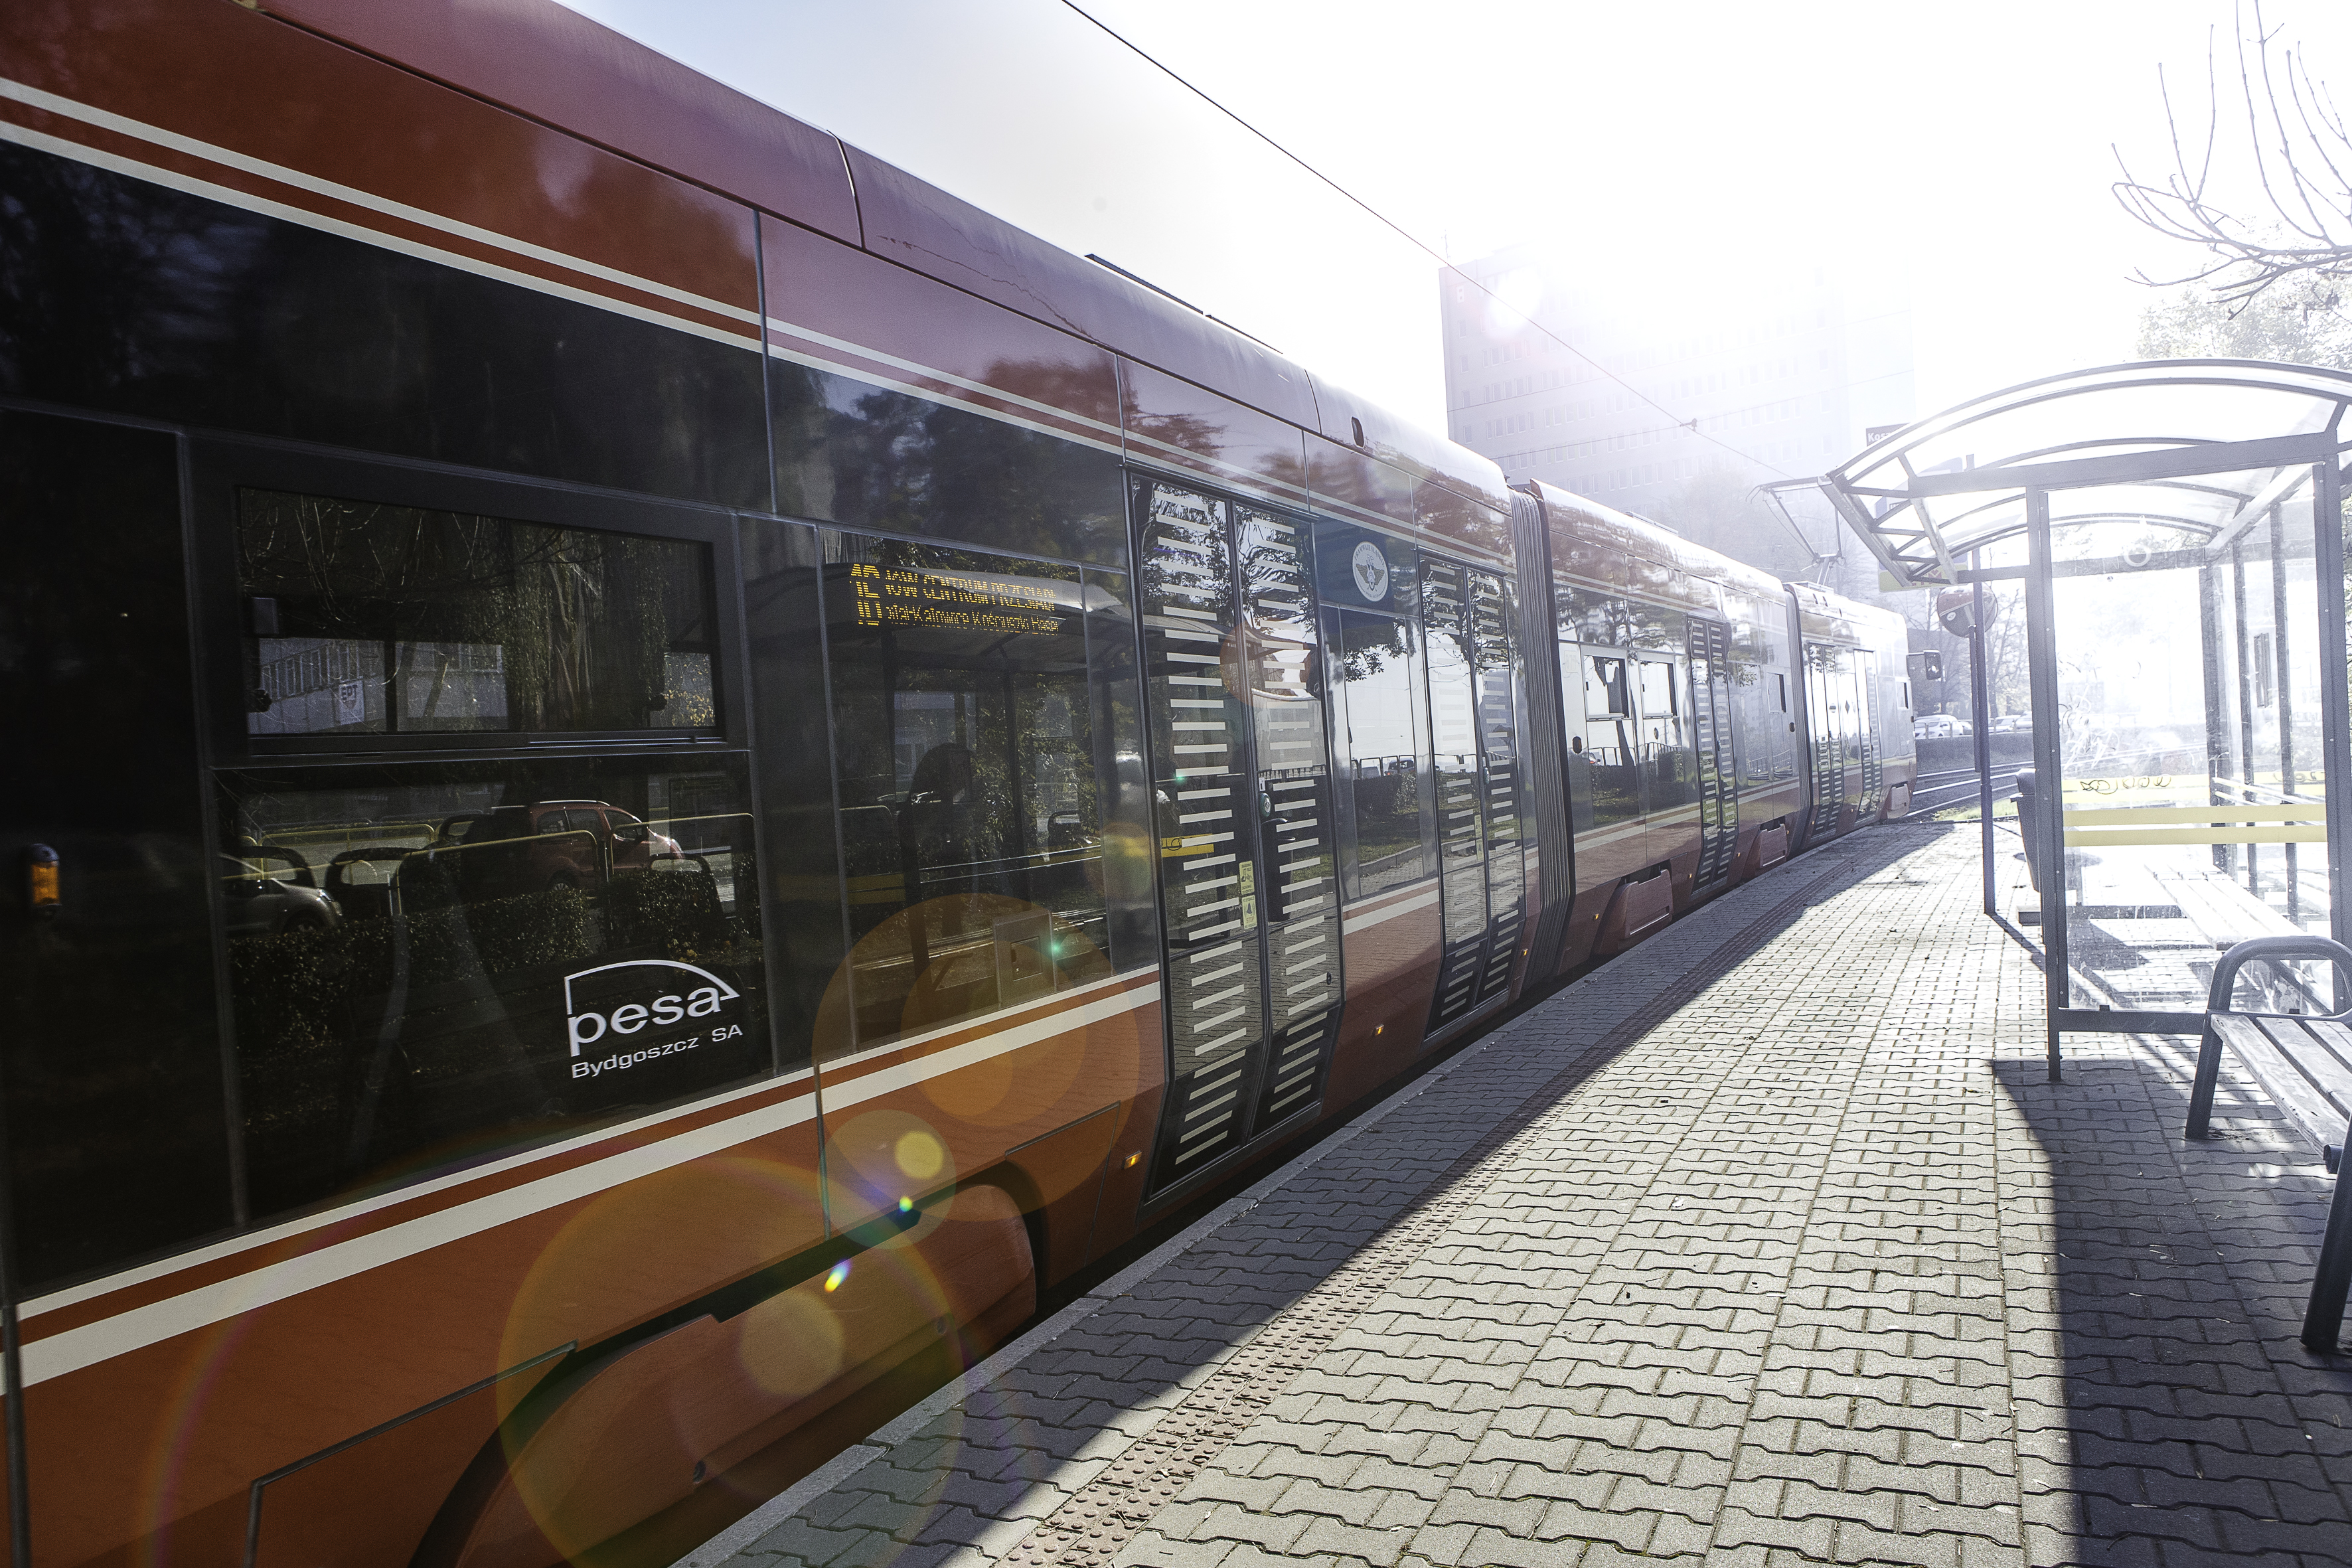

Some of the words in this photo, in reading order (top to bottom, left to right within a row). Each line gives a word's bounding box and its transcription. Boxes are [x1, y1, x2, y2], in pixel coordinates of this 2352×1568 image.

[568, 986, 722, 1057] pesa
[571, 1037, 700, 1079] Bydgoszcz
[712, 1024, 744, 1043] SA
